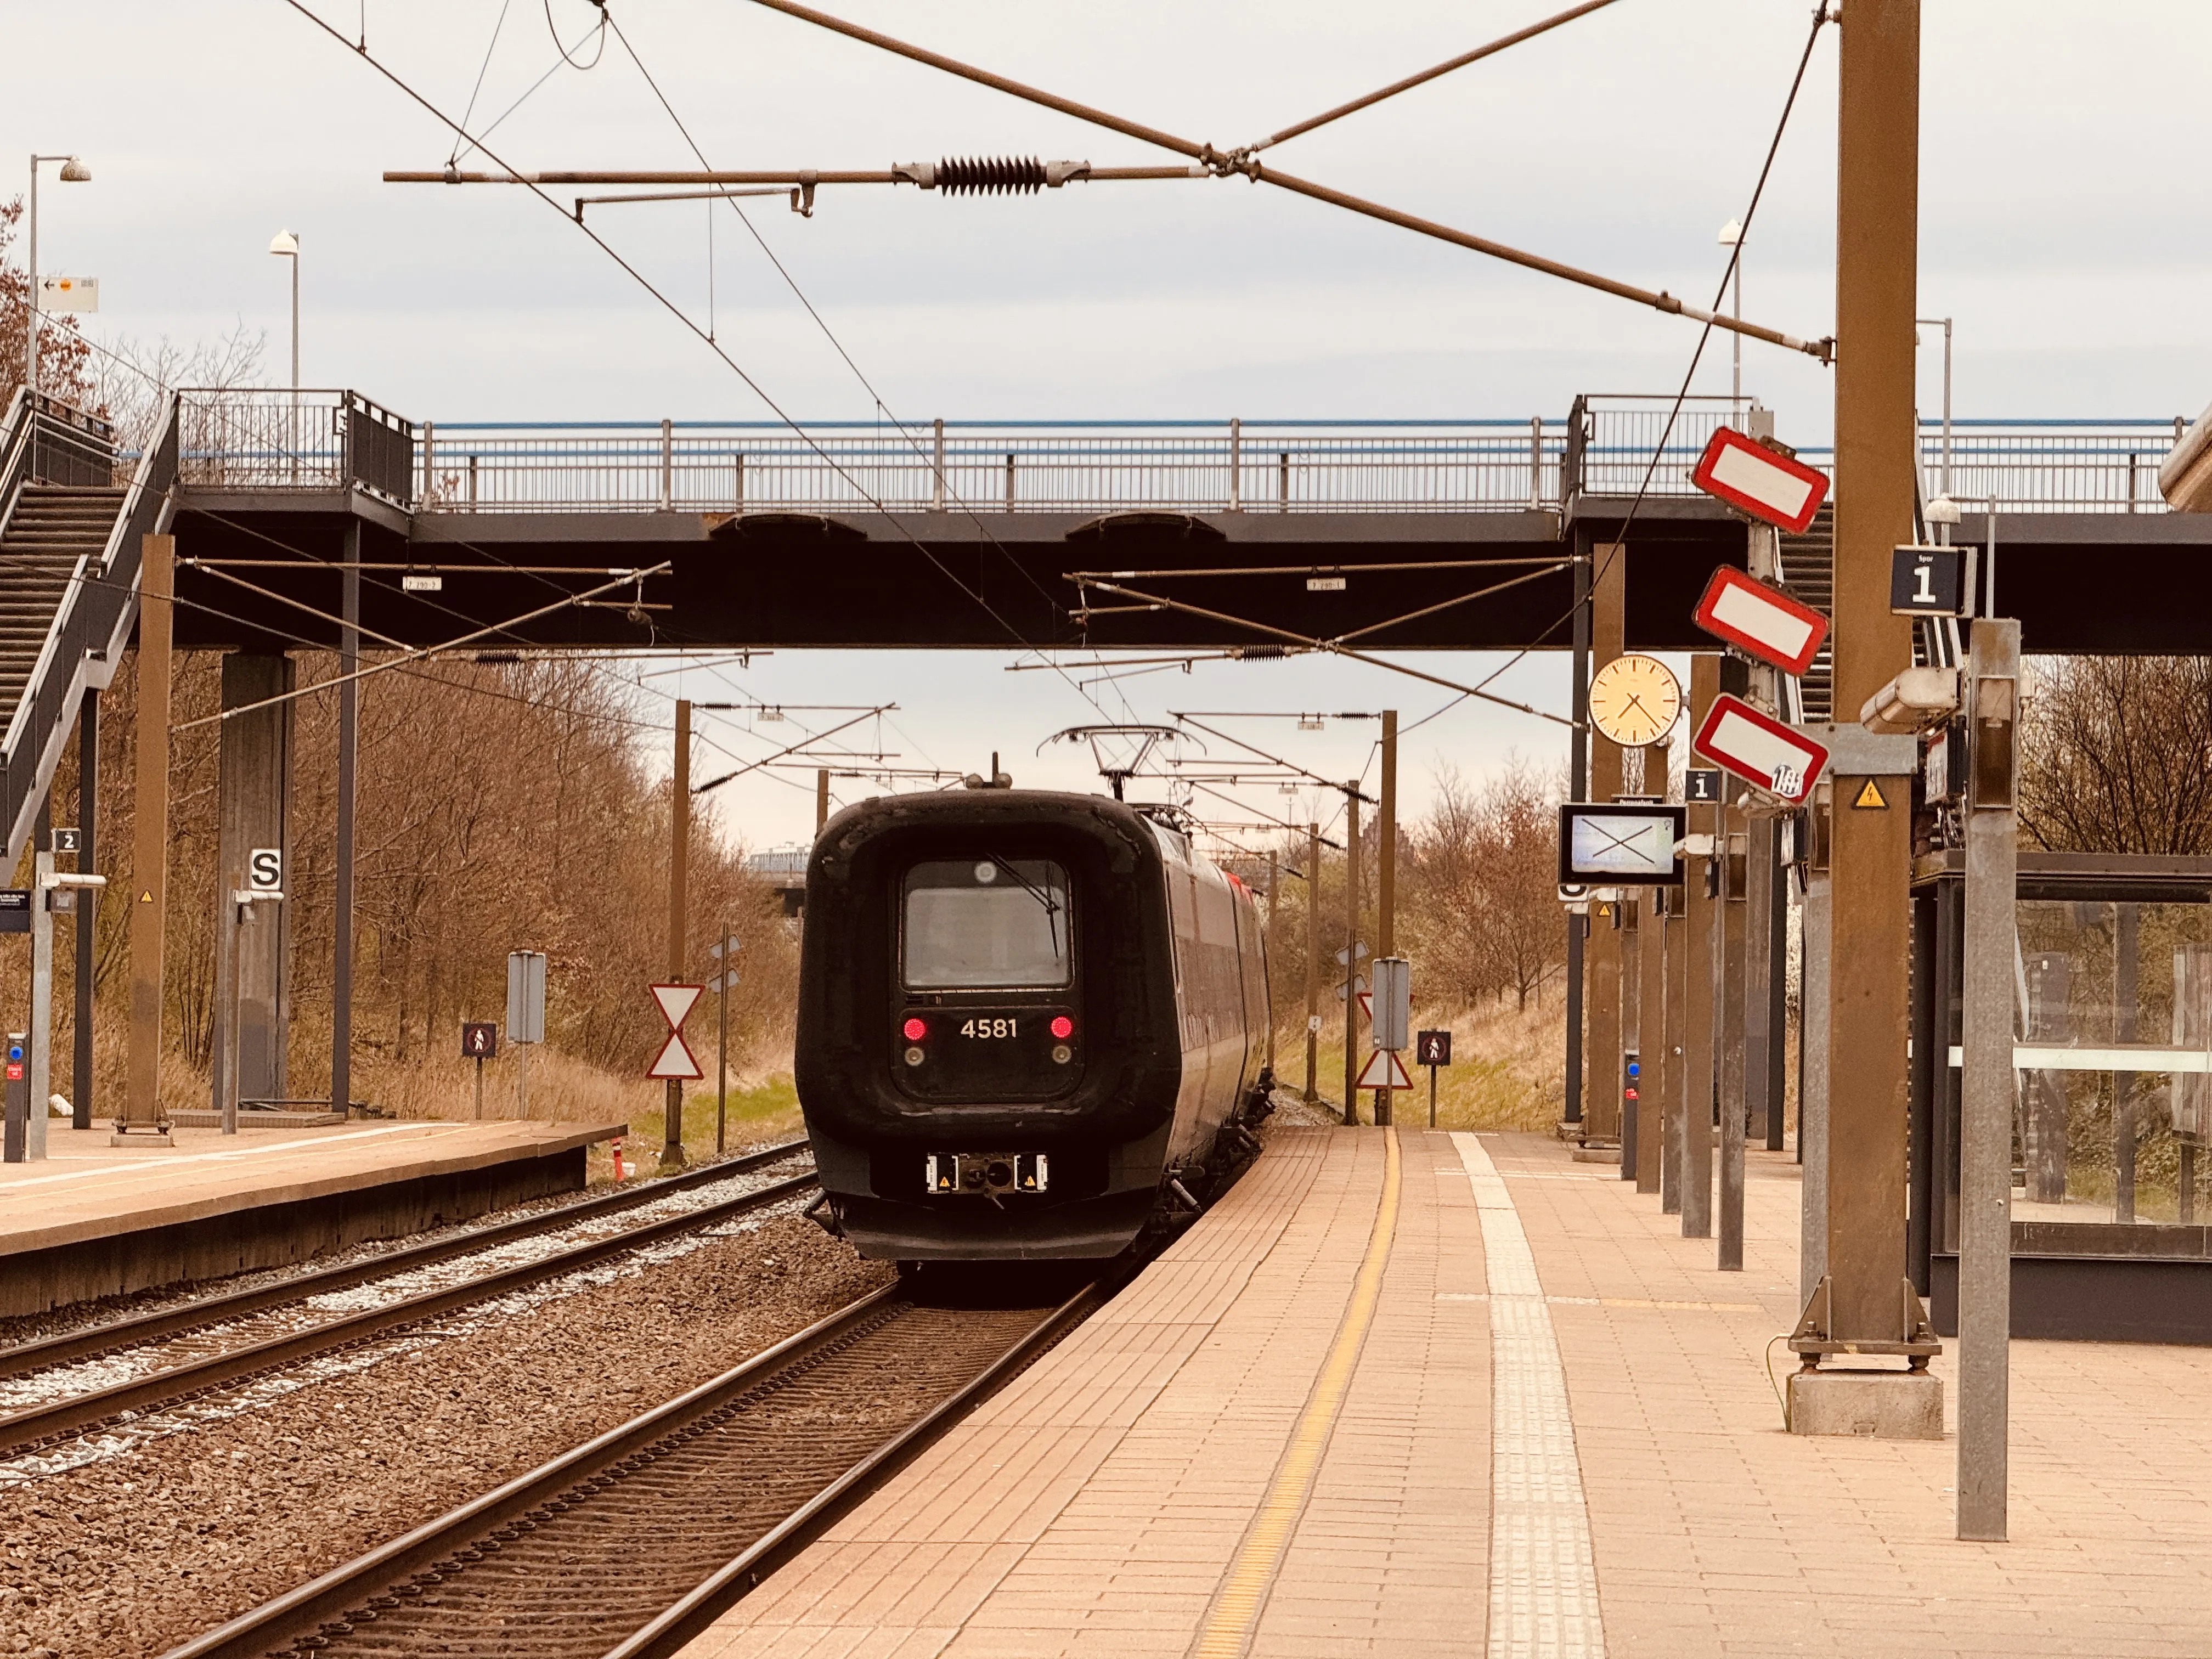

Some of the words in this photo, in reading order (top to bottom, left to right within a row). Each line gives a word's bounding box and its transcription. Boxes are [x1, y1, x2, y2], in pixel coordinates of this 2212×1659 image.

[1918, 554, 1934, 563] Spor
[1912, 566, 1936, 603] 1
[1695, 778, 1708, 798] 1
[64, 835, 74, 849] 2
[252, 853, 279, 885] S
[960, 1018, 1017, 1039] 4581
